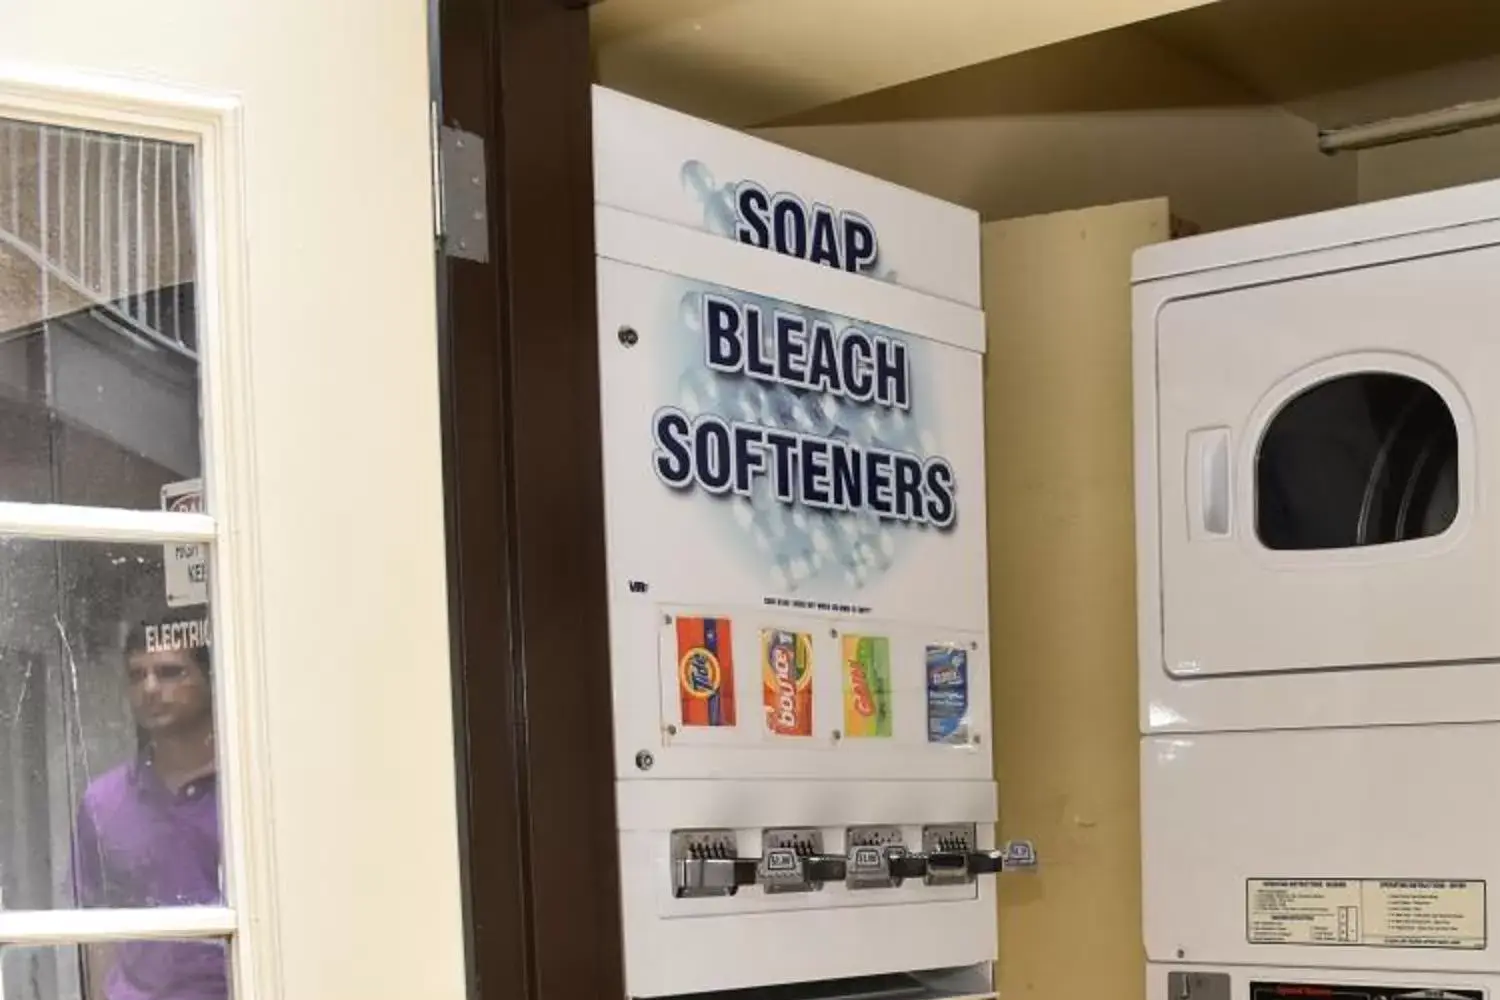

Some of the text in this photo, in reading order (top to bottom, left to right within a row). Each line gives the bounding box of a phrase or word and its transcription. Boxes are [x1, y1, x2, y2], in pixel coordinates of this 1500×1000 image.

[736, 185, 876, 273] SOAP
[705, 298, 909, 407] BLEACH
[655, 412, 955, 524] SOFTENERS
[691, 653, 715, 692] Tide
